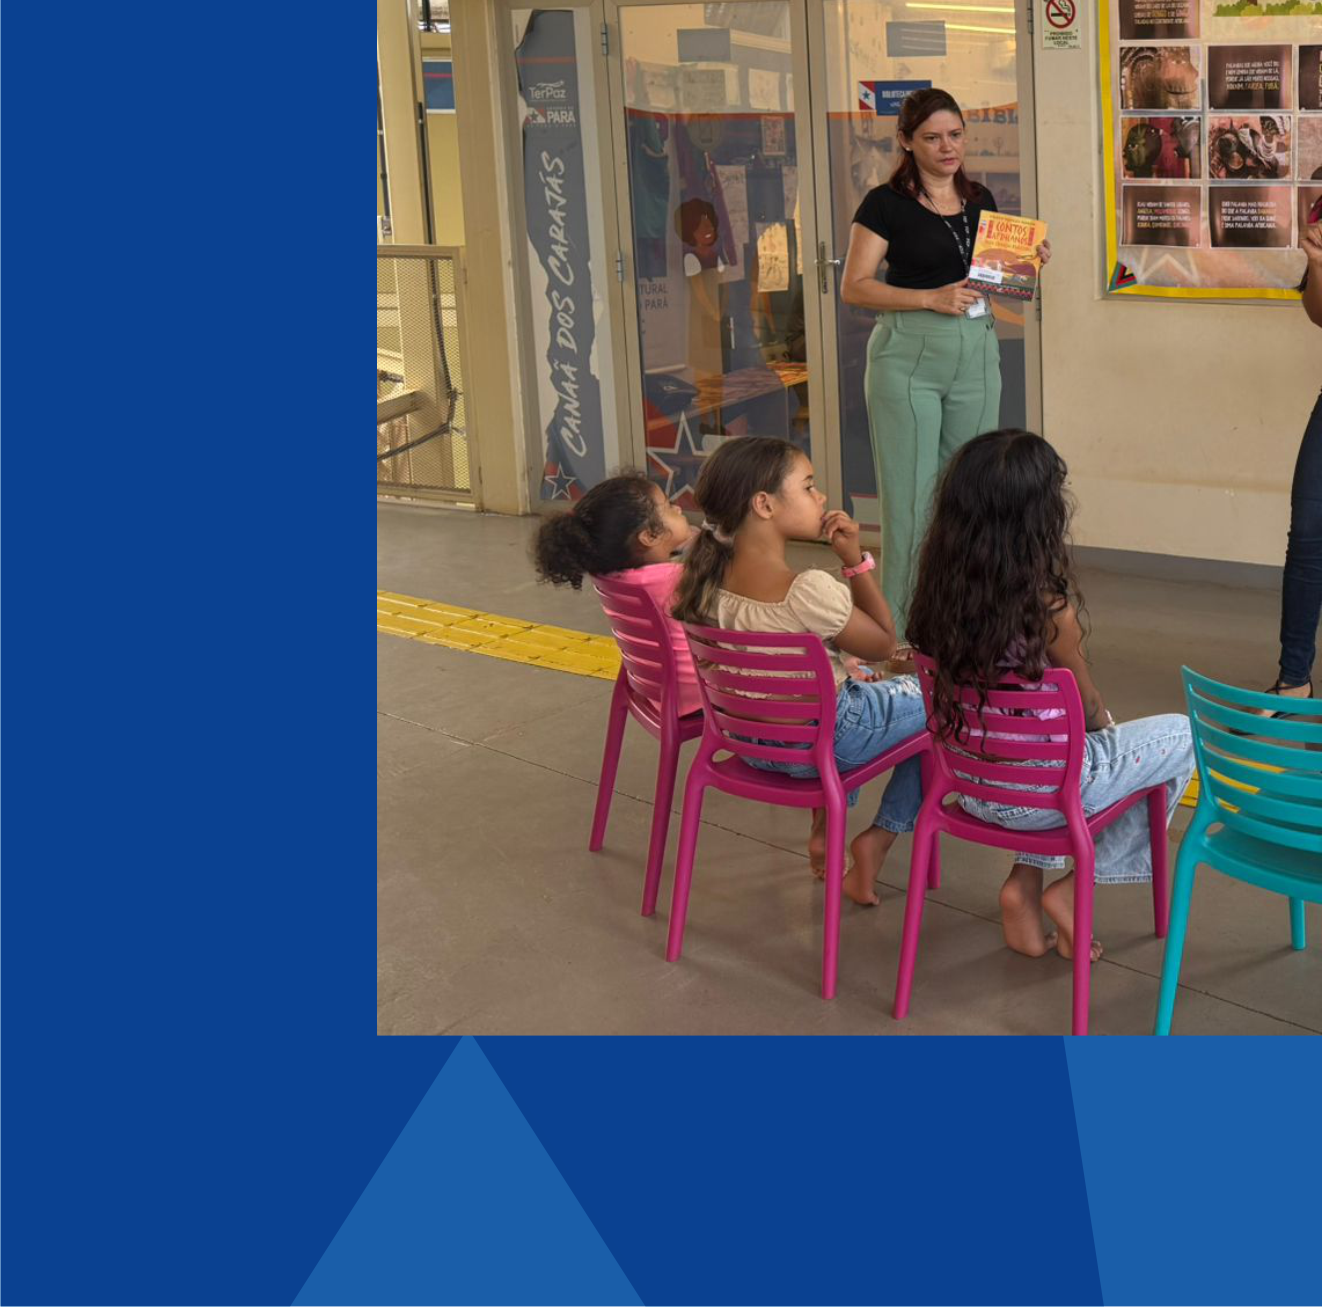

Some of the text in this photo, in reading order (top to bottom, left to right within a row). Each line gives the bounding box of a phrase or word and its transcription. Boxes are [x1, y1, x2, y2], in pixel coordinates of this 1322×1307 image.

[528, 86, 567, 100] TerPaz
[540, 151, 587, 458] CANAÃ DOS CARAJÁS
